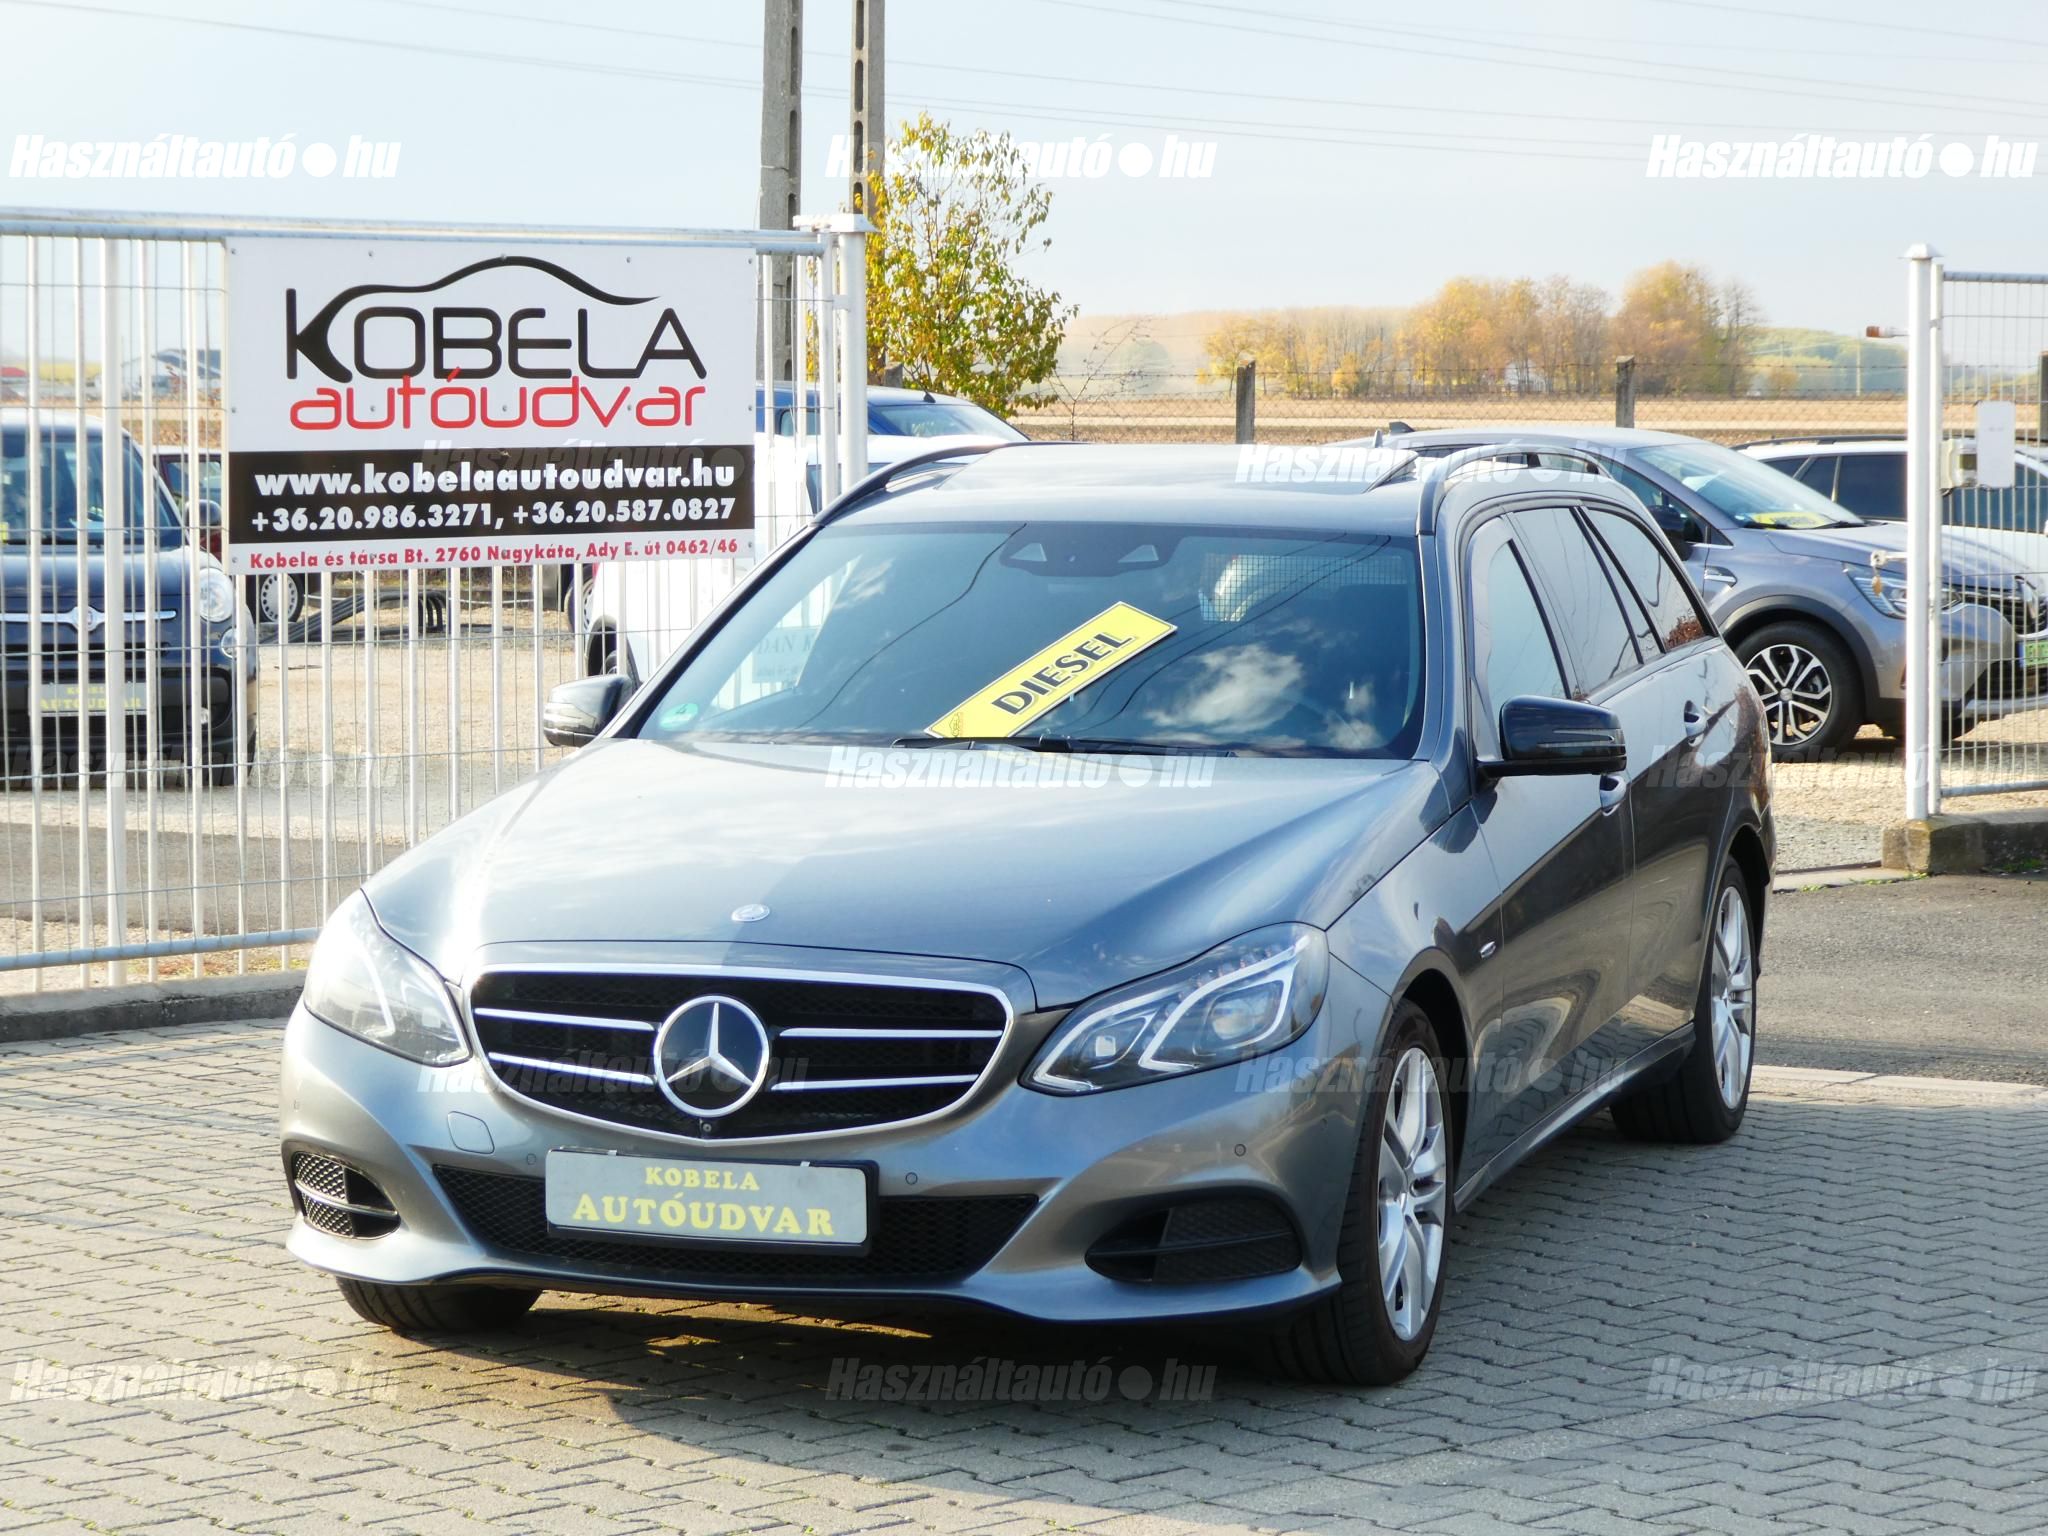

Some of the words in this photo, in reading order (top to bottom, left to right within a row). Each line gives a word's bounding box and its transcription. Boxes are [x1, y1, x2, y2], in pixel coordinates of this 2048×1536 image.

[286, 288, 707, 384] KOBELA
[290, 366, 707, 430] autóudvar
[254, 457, 735, 496] www.kobelaautoudvar.hu
[252, 502, 504, 532] +36.20.986.3271,
[513, 497, 736, 525] +36.20.587.0827
[250, 551, 318, 569] Kobela
[324, 549, 344, 566] és
[350, 549, 398, 566] társa
[404, 548, 429, 564] Bt.
[435, 546, 481, 563] 2760
[487, 543, 581, 563] Nagykáta,
[586, 541, 619, 561] Ady
[624, 541, 639, 556] E.
[644, 540, 661, 556] út
[666, 538, 738, 555] 0462/46
[991, 632, 1134, 715] DIESEL
[646, 1166, 760, 1191] KOBELA
[572, 1192, 834, 1236] AUTÓUDVAR
